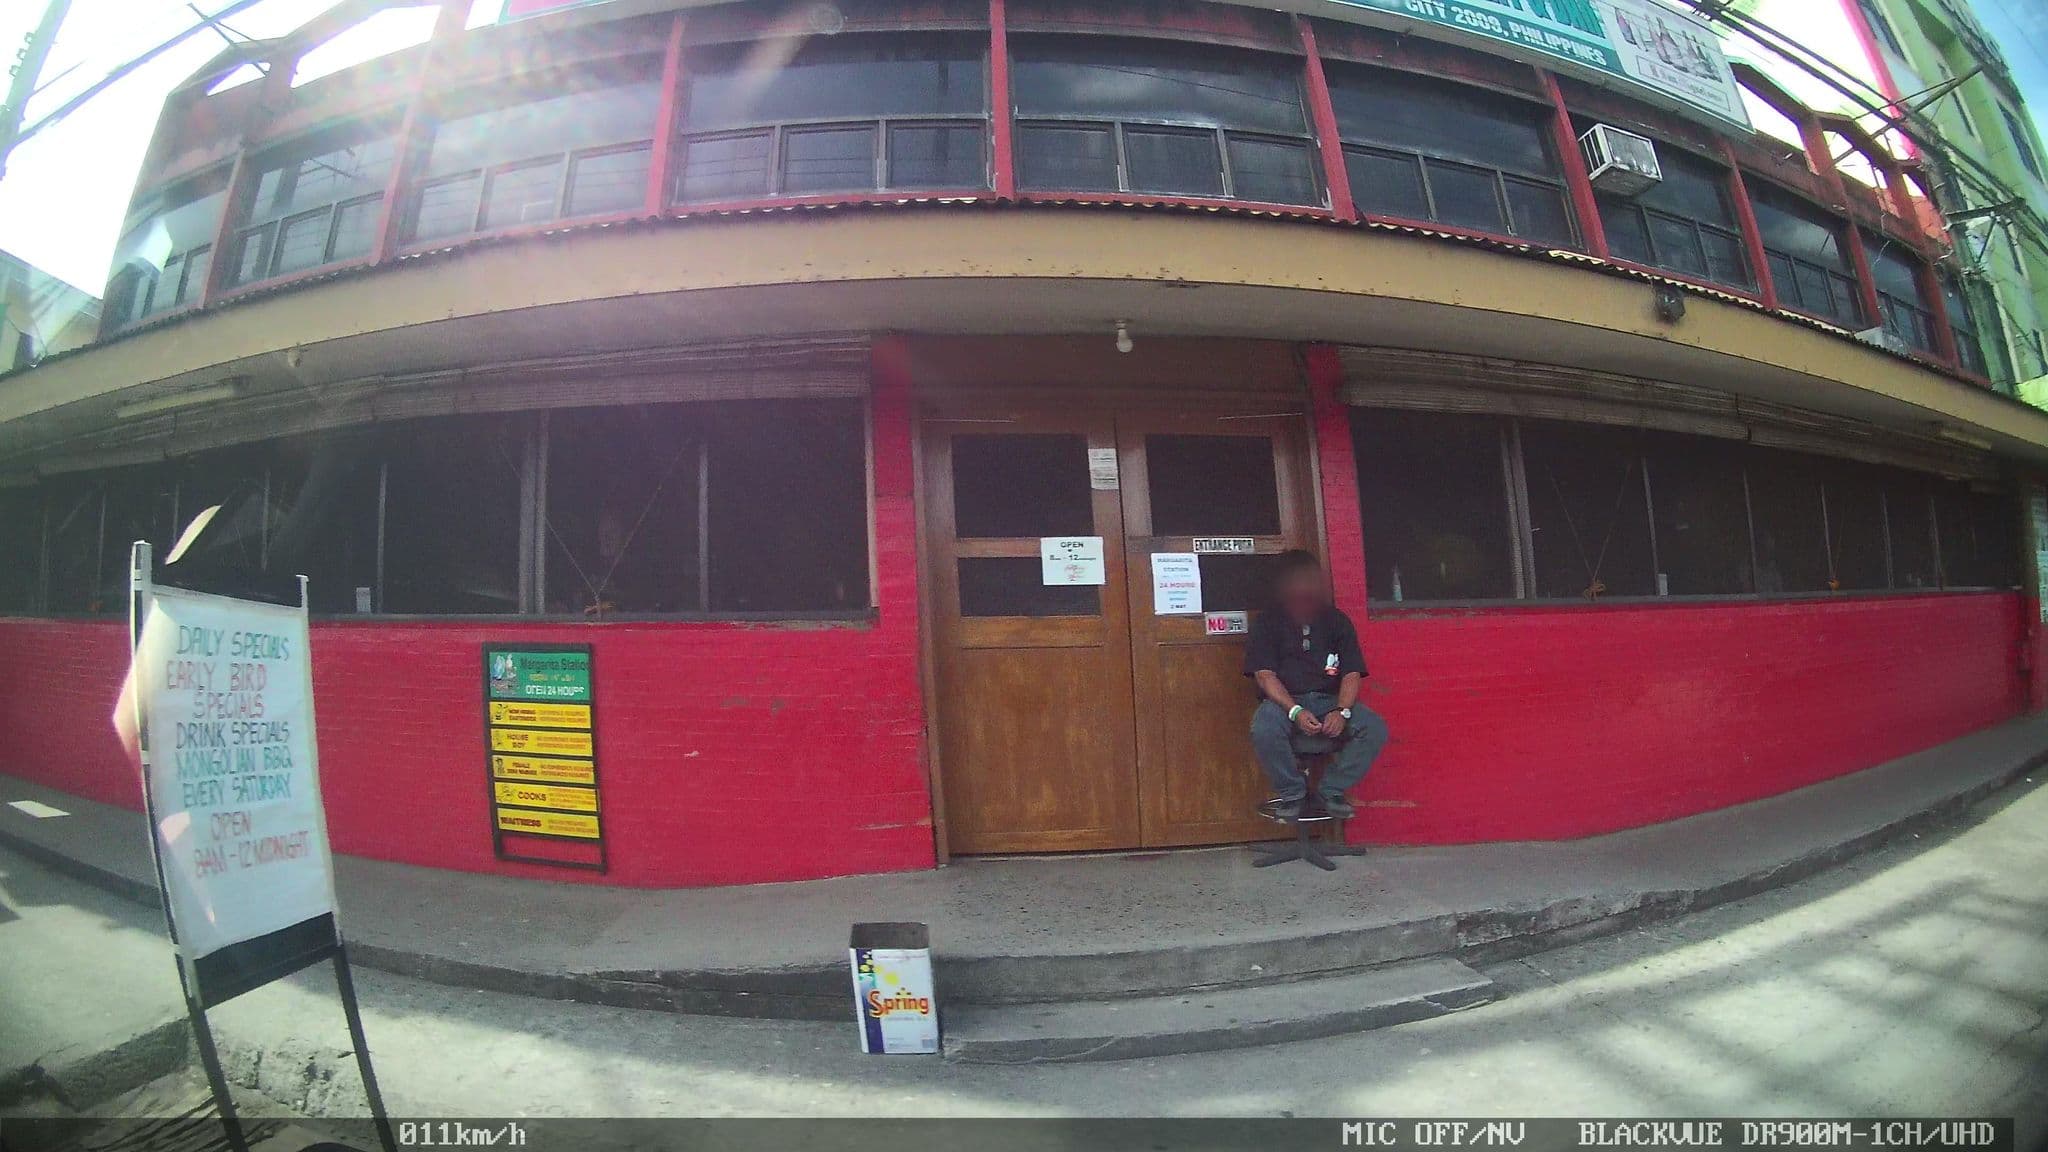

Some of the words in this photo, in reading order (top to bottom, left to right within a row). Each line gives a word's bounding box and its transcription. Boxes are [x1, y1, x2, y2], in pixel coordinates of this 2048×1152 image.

[1406, 0, 1446, 19] CITY
[1508, 21, 1607, 66] PHILIPPINES
[1195, 539, 1231, 551] ENTRANCE
[1208, 617, 1226, 631] NO
[176, 625, 225, 657] DAILY
[231, 631, 290, 661] SPECIALS
[166, 660, 216, 691] EARLY
[230, 662, 267, 692] BIRD
[561, 658, 592, 671] Statio
[192, 690, 265, 719] SPECIALS
[526, 684, 546, 695] OPEN
[547, 685, 557, 696] 24
[176, 721, 226, 750] DRINK
[231, 721, 290, 745] SPECIALS
[175, 748, 255, 779] MONGOLIAN
[263, 744, 293, 770] BBQ
[183, 780, 225, 809] EVERY
[231, 773, 292, 803] SATURDAY
[518, 791, 547, 802] COOKS
[211, 810, 252, 841] OPEN
[868, 989, 930, 1018] Spring
